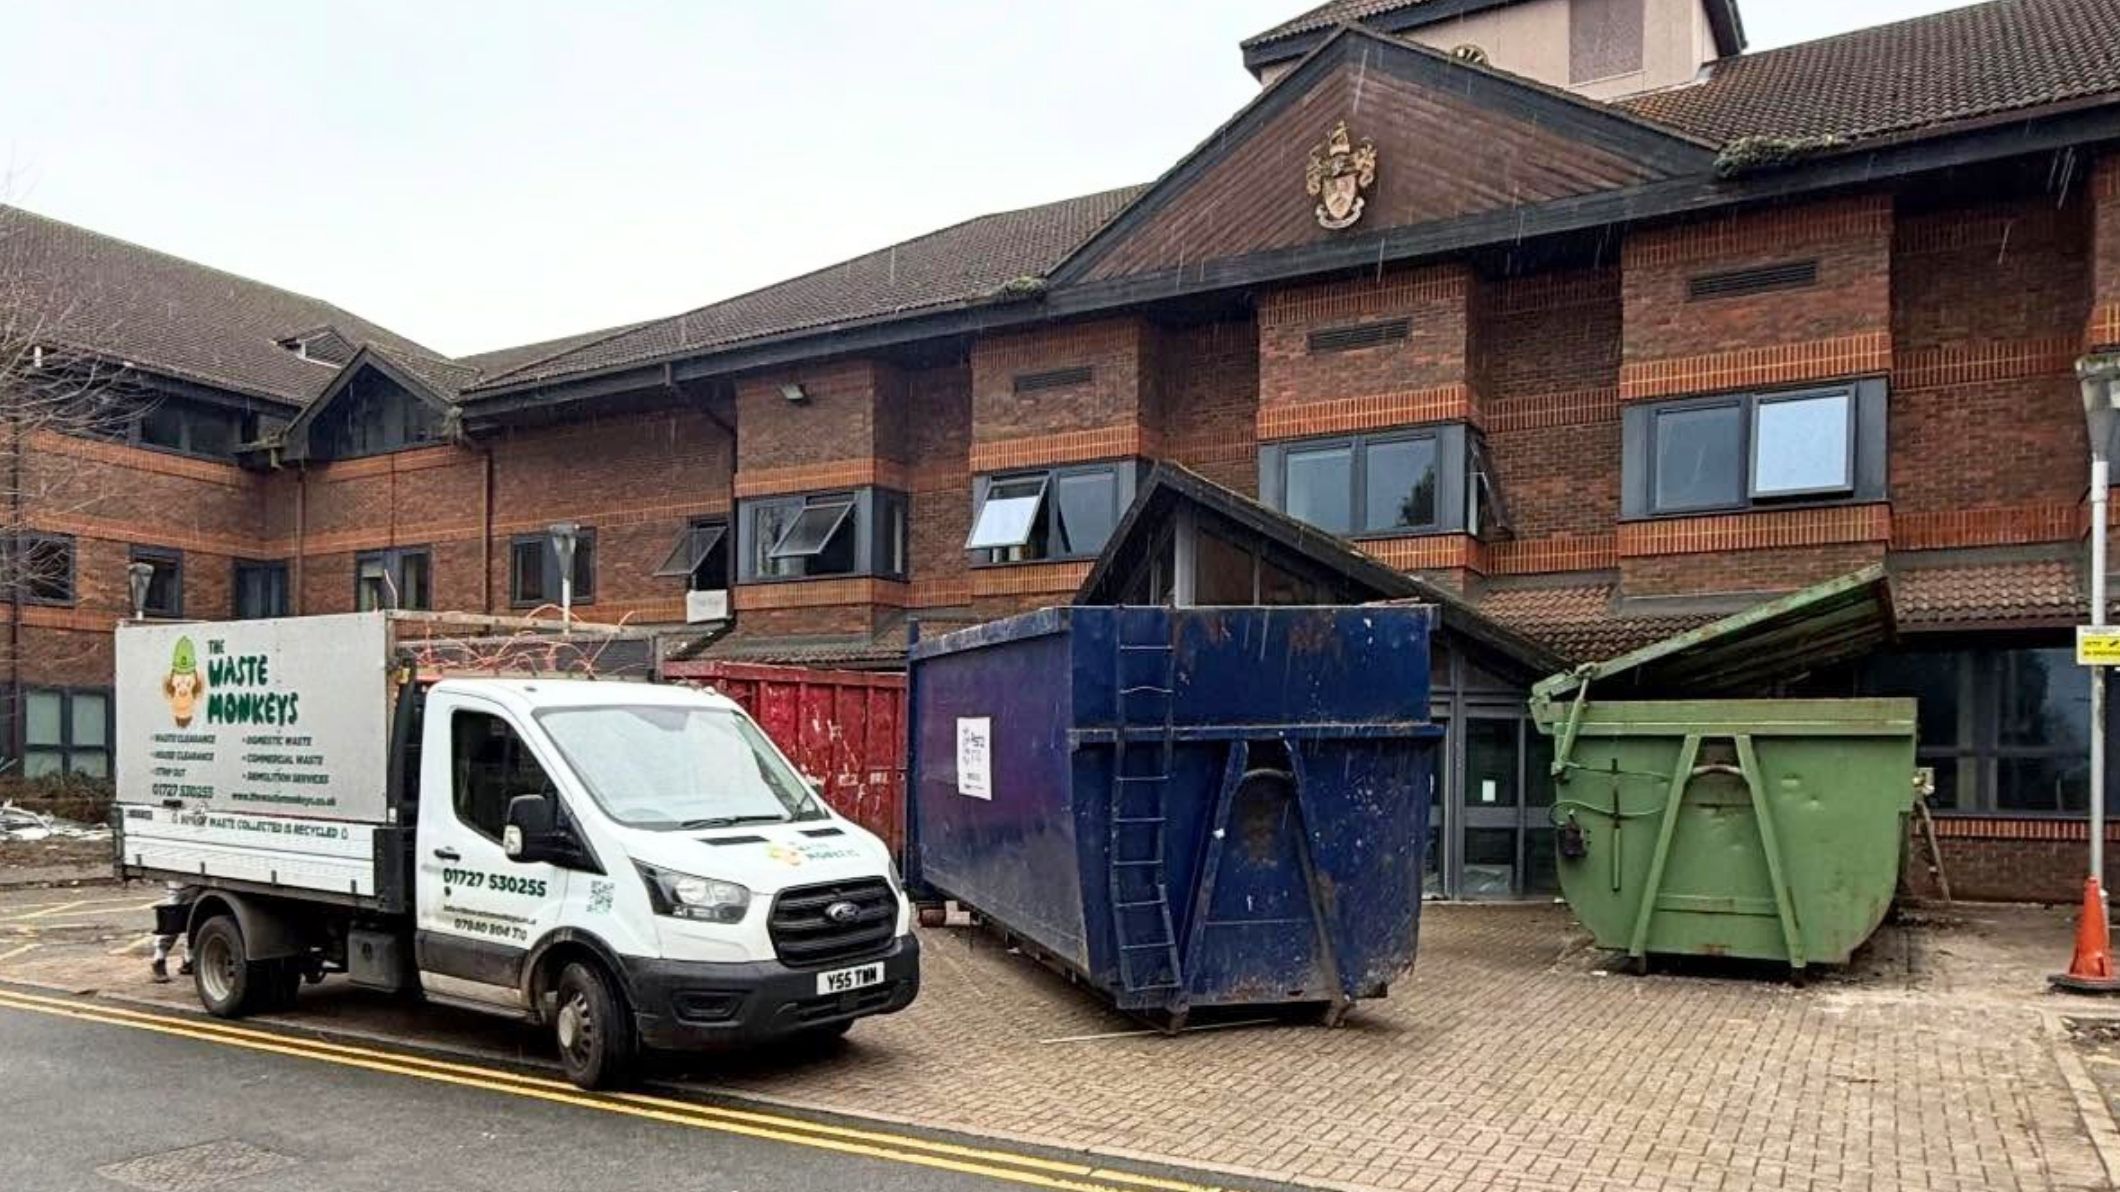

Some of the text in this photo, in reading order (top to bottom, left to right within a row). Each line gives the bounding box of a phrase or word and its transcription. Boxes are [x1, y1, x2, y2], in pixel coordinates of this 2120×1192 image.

[207, 639, 225, 655] THE
[207, 654, 268, 687] WASTE
[207, 692, 299, 726] MONKEYS
[152, 783, 179, 797] 01727
[443, 867, 547, 898] 01727 530255
[827, 971, 852, 991] Y55
